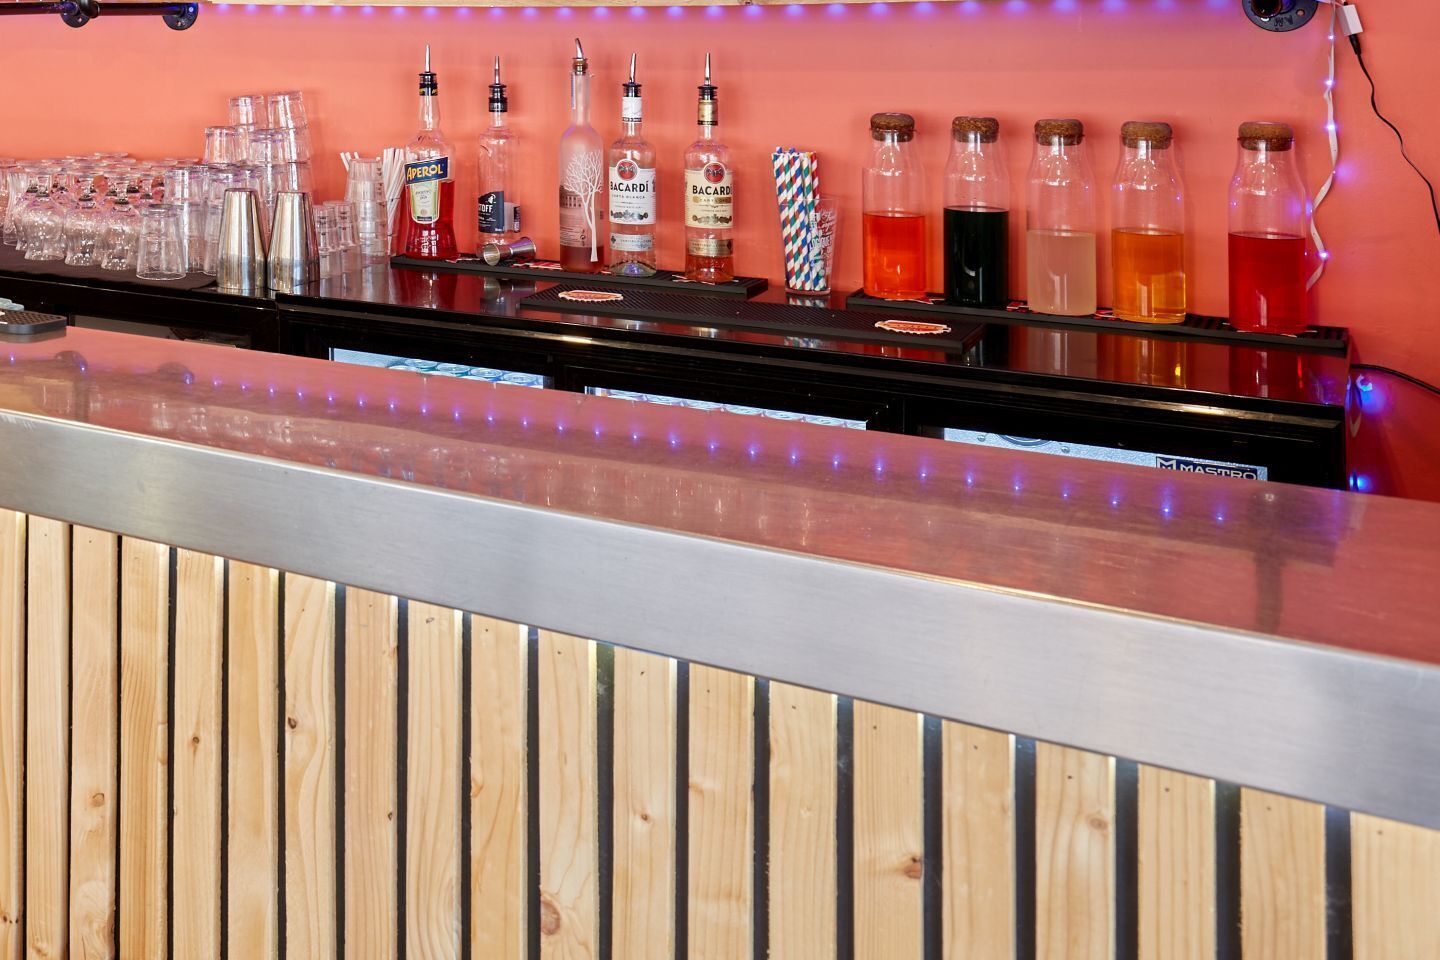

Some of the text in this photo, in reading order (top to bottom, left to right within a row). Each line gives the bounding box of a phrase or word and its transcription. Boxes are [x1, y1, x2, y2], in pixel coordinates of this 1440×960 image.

[406, 163, 444, 181] APEROL
[610, 181, 649, 193] BACARDÍ
[1180, 464, 1257, 480] MASTRO
